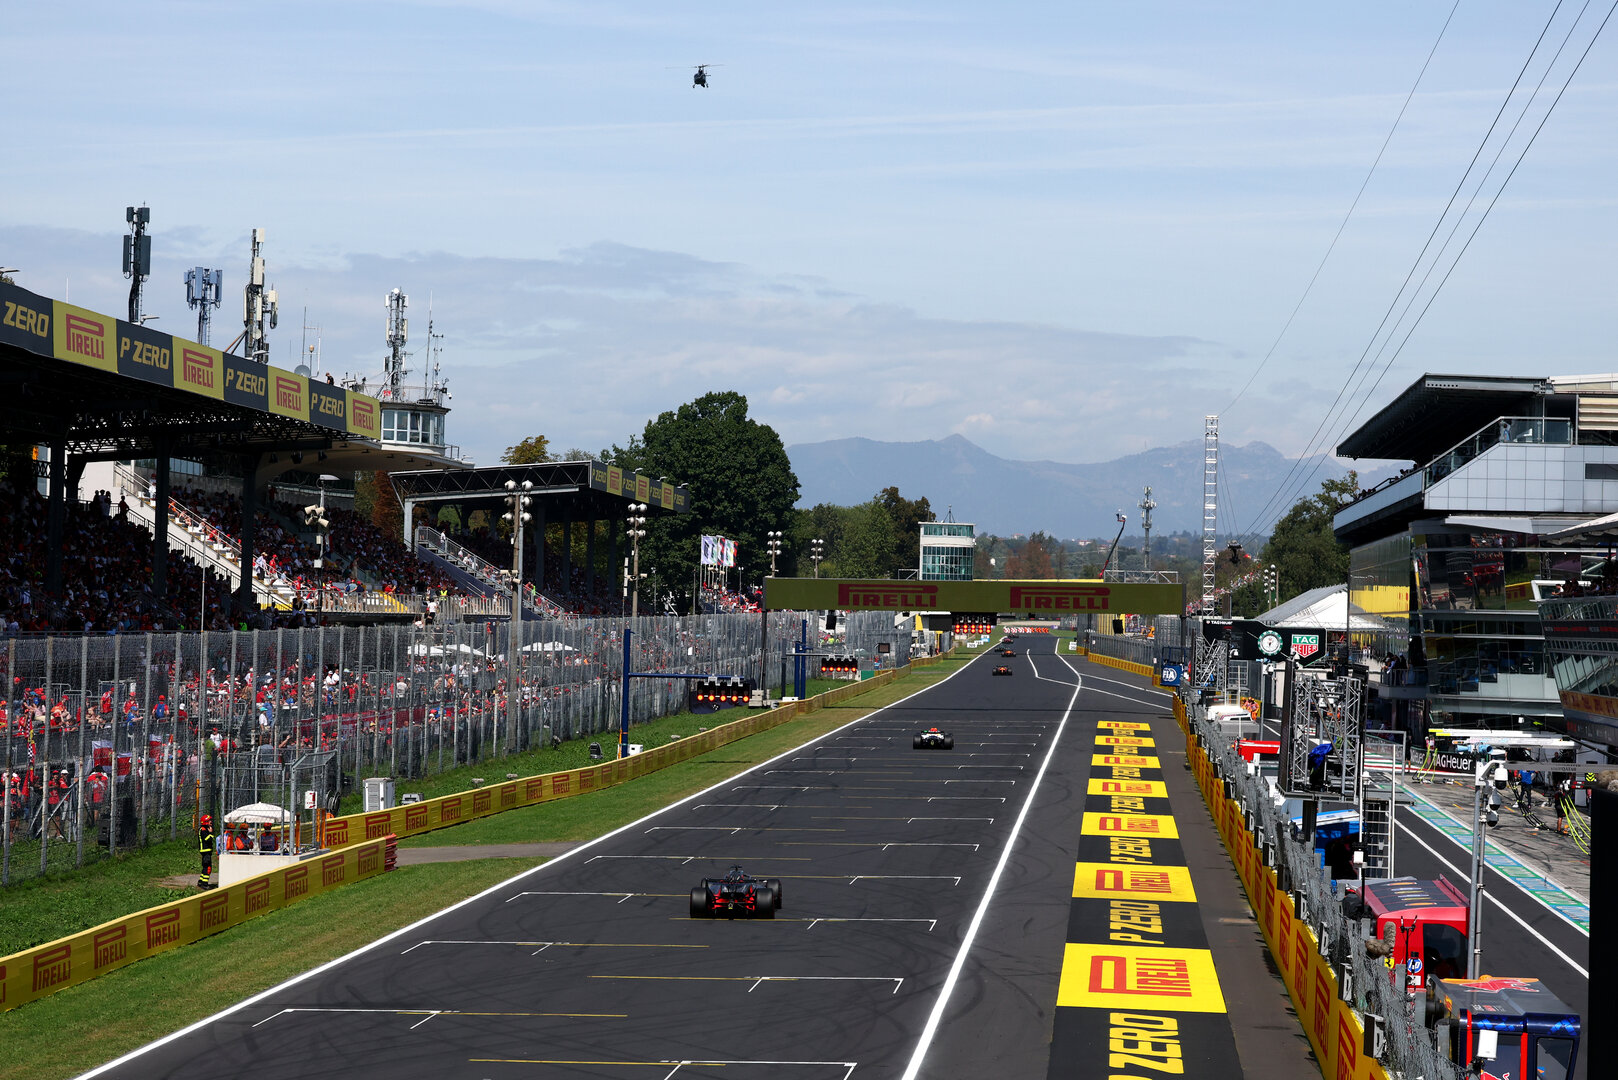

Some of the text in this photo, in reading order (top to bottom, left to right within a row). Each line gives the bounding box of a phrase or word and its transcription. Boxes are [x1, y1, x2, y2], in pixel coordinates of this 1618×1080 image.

[3, 301, 49, 338] ZERO
[66, 313, 104, 360] PIRELLI
[120, 337, 170, 370] P ZERO
[183, 348, 213, 388] PIRELLI
[226, 368, 266, 397] P ZERO
[276, 376, 301, 411] PIRELLI
[311, 392, 344, 418] P ZERO
[352, 399, 374, 430] PIRELLI
[838, 583, 938, 608] PIRELLI
[1009, 586, 1111, 610] PIRELLI
[1294, 636, 1317, 644] TAG
[1162, 670, 1175, 679] FIA
[1433, 752, 1473, 771] TAGHeuer
[365, 813, 391, 840] PIRELLI
[406, 805, 428, 831] PIRELLI
[441, 798, 461, 822] PIRELLI
[326, 820, 349, 847] PRELLI
[322, 854, 345, 887] PIRELLI
[358, 844, 379, 876] PIRELLI
[245, 877, 270, 914] PIRELLI
[284, 865, 308, 900] PIRELLI
[200, 891, 229, 931] PIRELLI
[1109, 900, 1165, 945] P ZERO
[146, 908, 180, 950] PIRELLI
[94, 925, 127, 970] PIRELLI
[32, 944, 71, 992] PIRELLI
[1088, 955, 1193, 997] PIRELLI
[1314, 965, 1330, 1061] PIRELLI
[1109, 1012, 1184, 1074] ZERO
